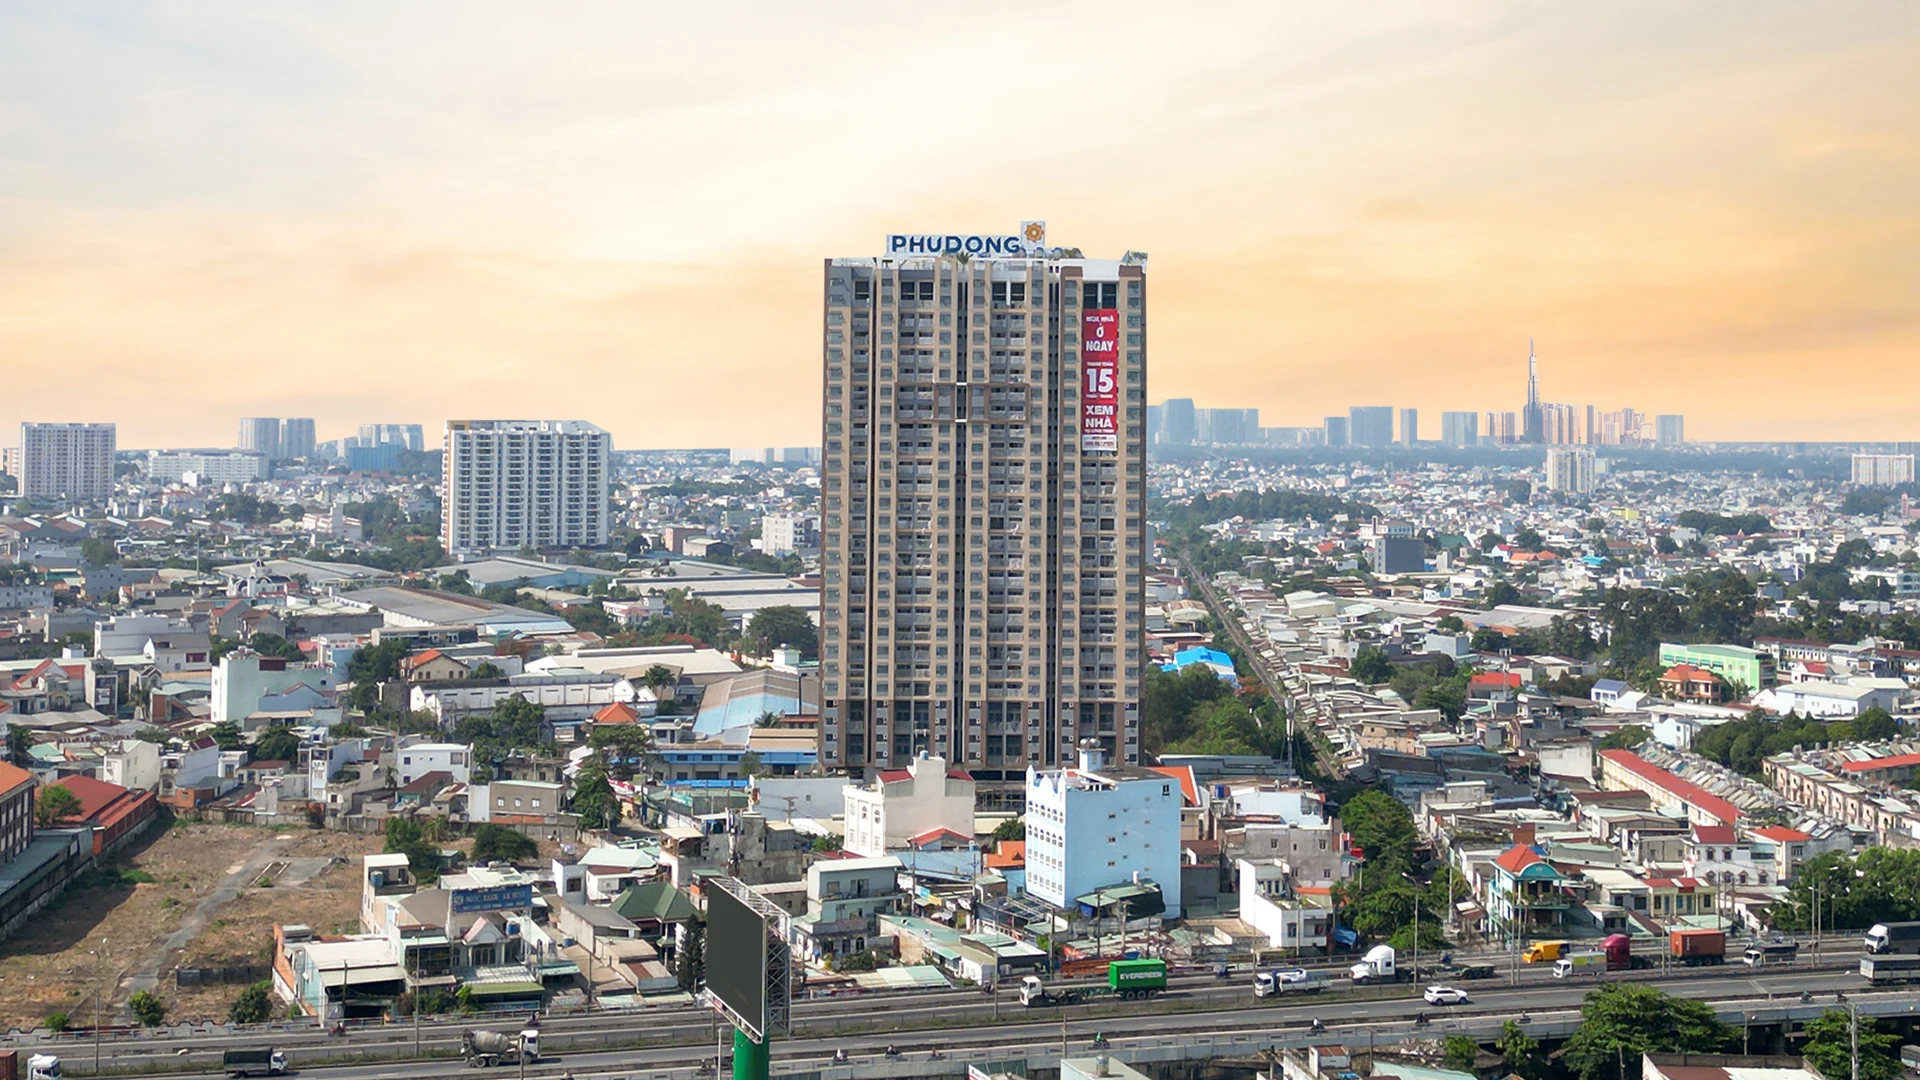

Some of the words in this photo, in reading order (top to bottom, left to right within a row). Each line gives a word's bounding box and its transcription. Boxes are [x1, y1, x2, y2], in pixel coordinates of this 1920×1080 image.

[892, 235, 1020, 253] PHUDONG
[1086, 340, 1114, 351] NGAY
[1086, 368, 1114, 393] 15
[1085, 405, 1113, 415] XEM
[1085, 416, 1113, 428] NHÀ
